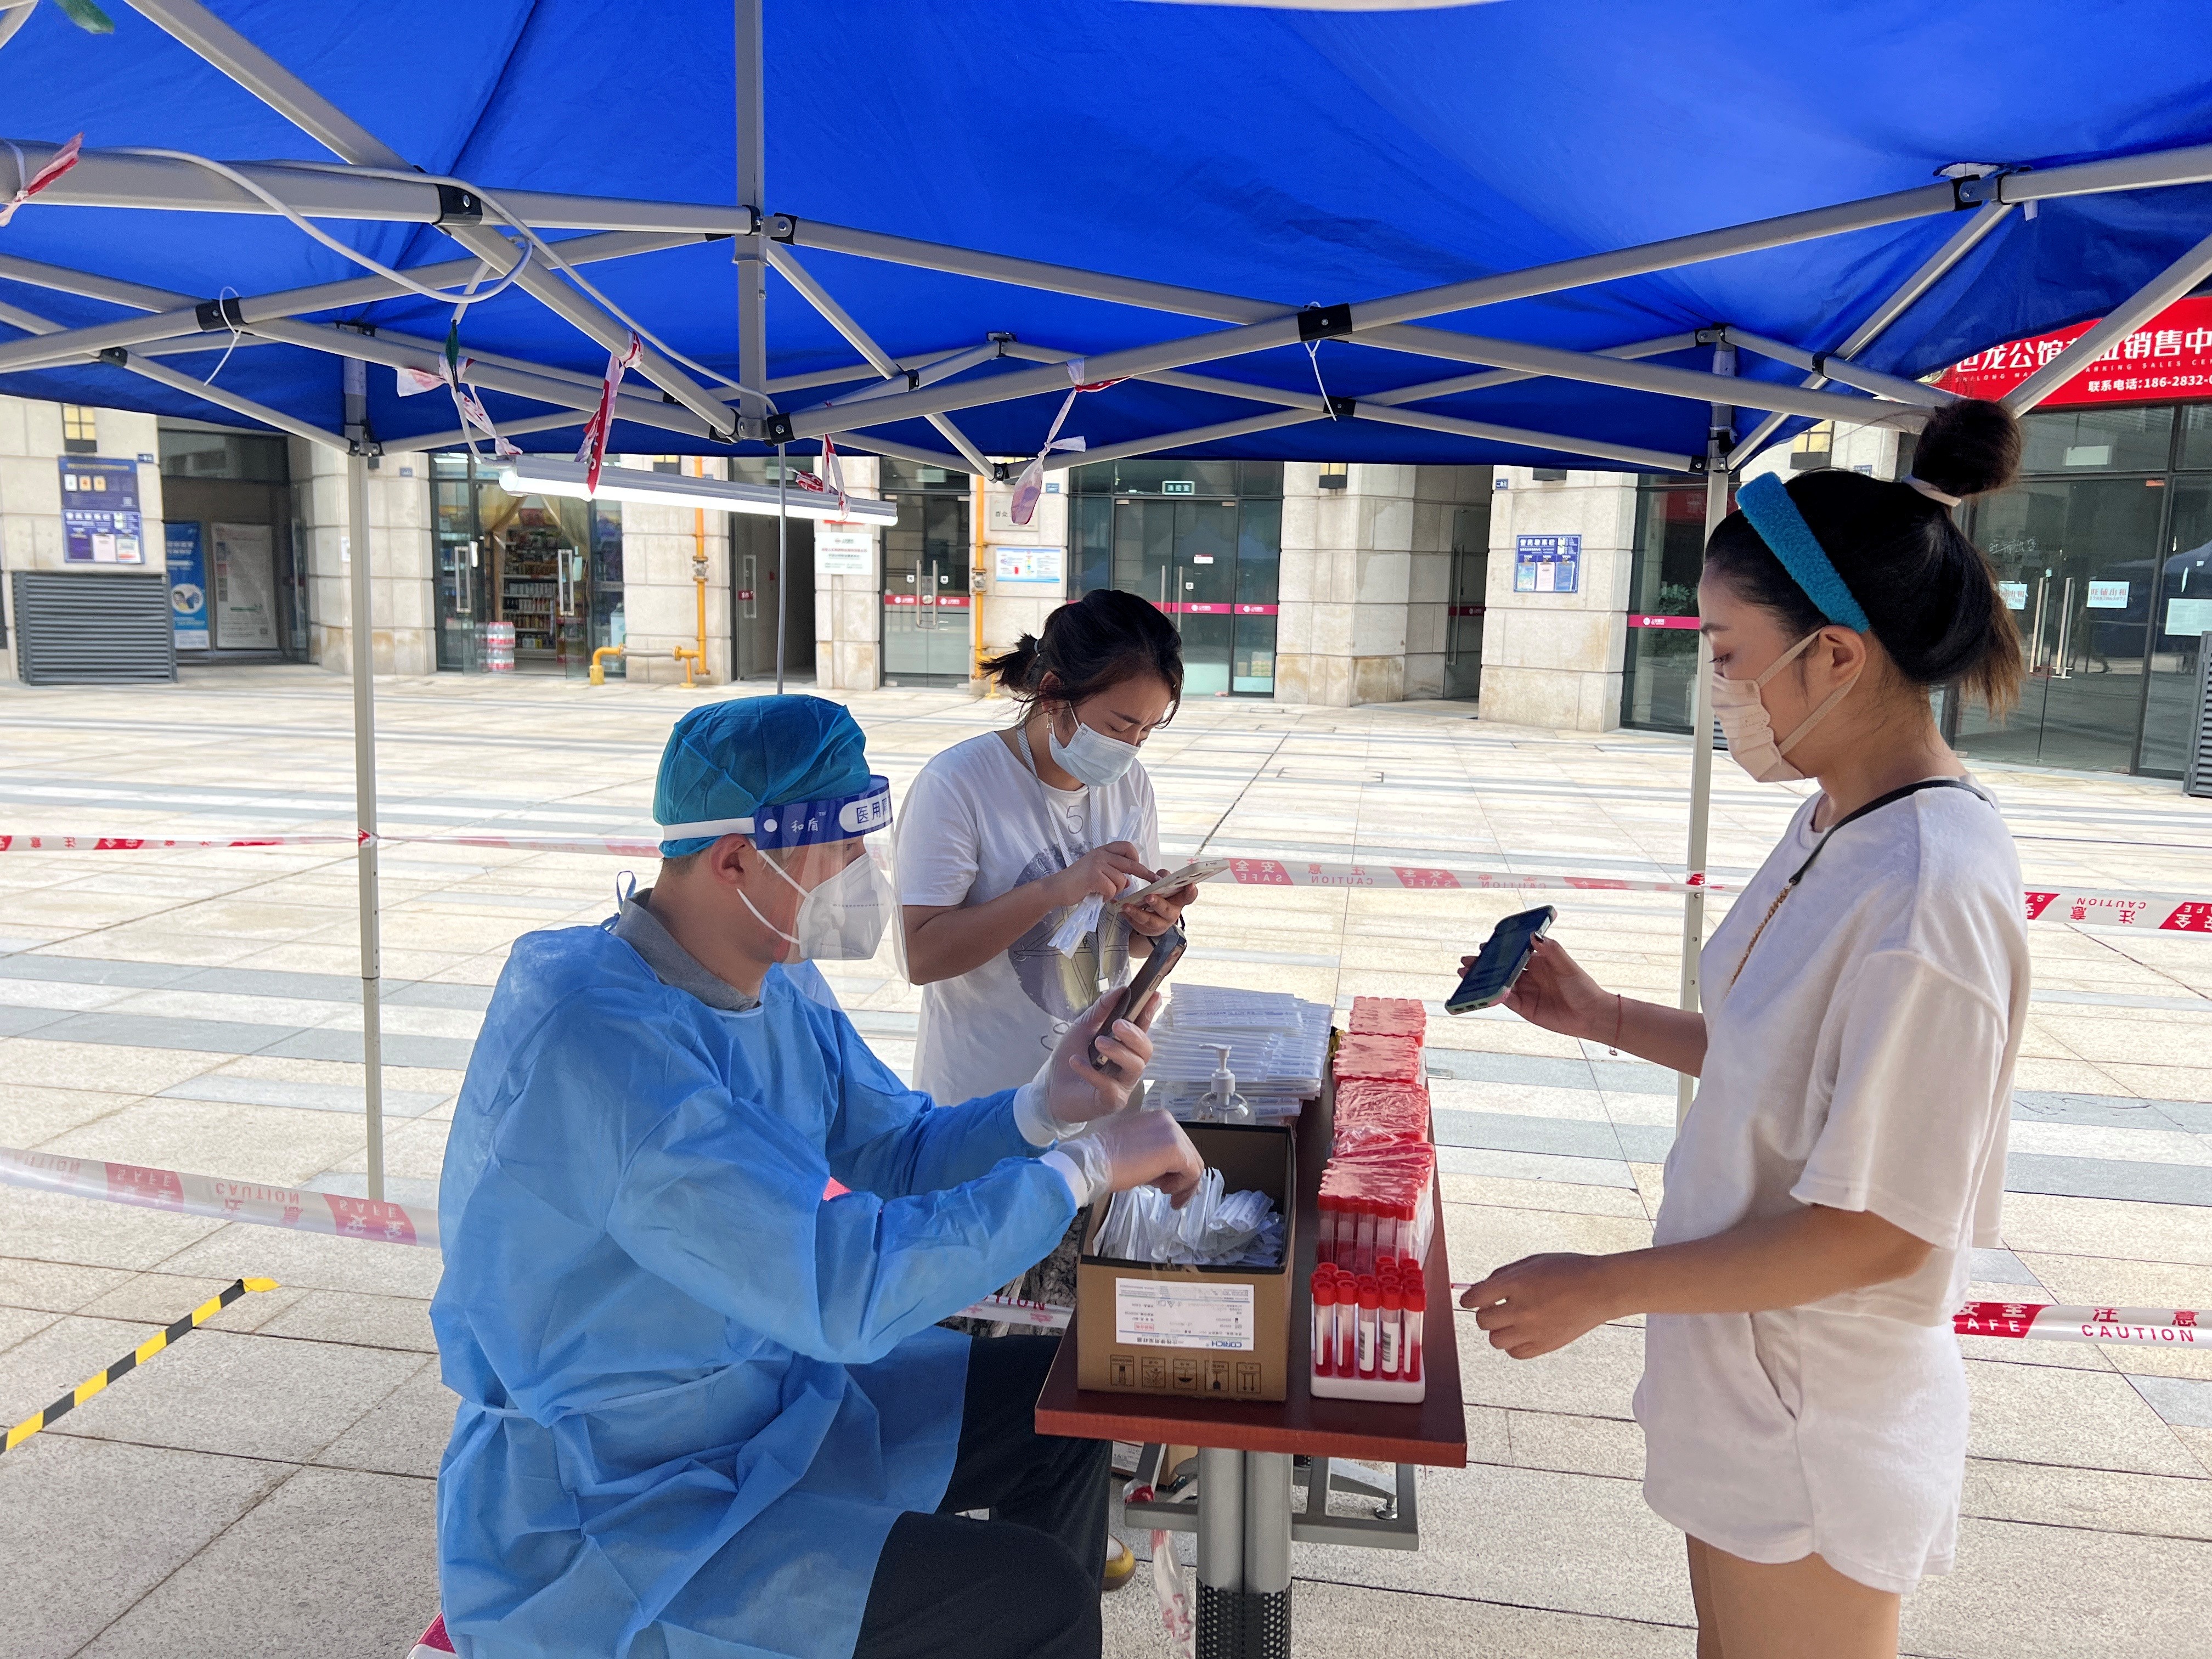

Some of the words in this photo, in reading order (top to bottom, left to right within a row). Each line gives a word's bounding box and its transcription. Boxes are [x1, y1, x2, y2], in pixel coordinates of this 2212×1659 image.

[2085, 364, 2132, 373] ARKING
[2142, 360, 2181, 369] SALES
[2076, 897, 2146, 909] CAUTION
[2070, 906, 2136, 924] 注意
[2092, 1308, 2199, 1327] 注意
[2081, 1324, 2194, 1343] CAUTION
